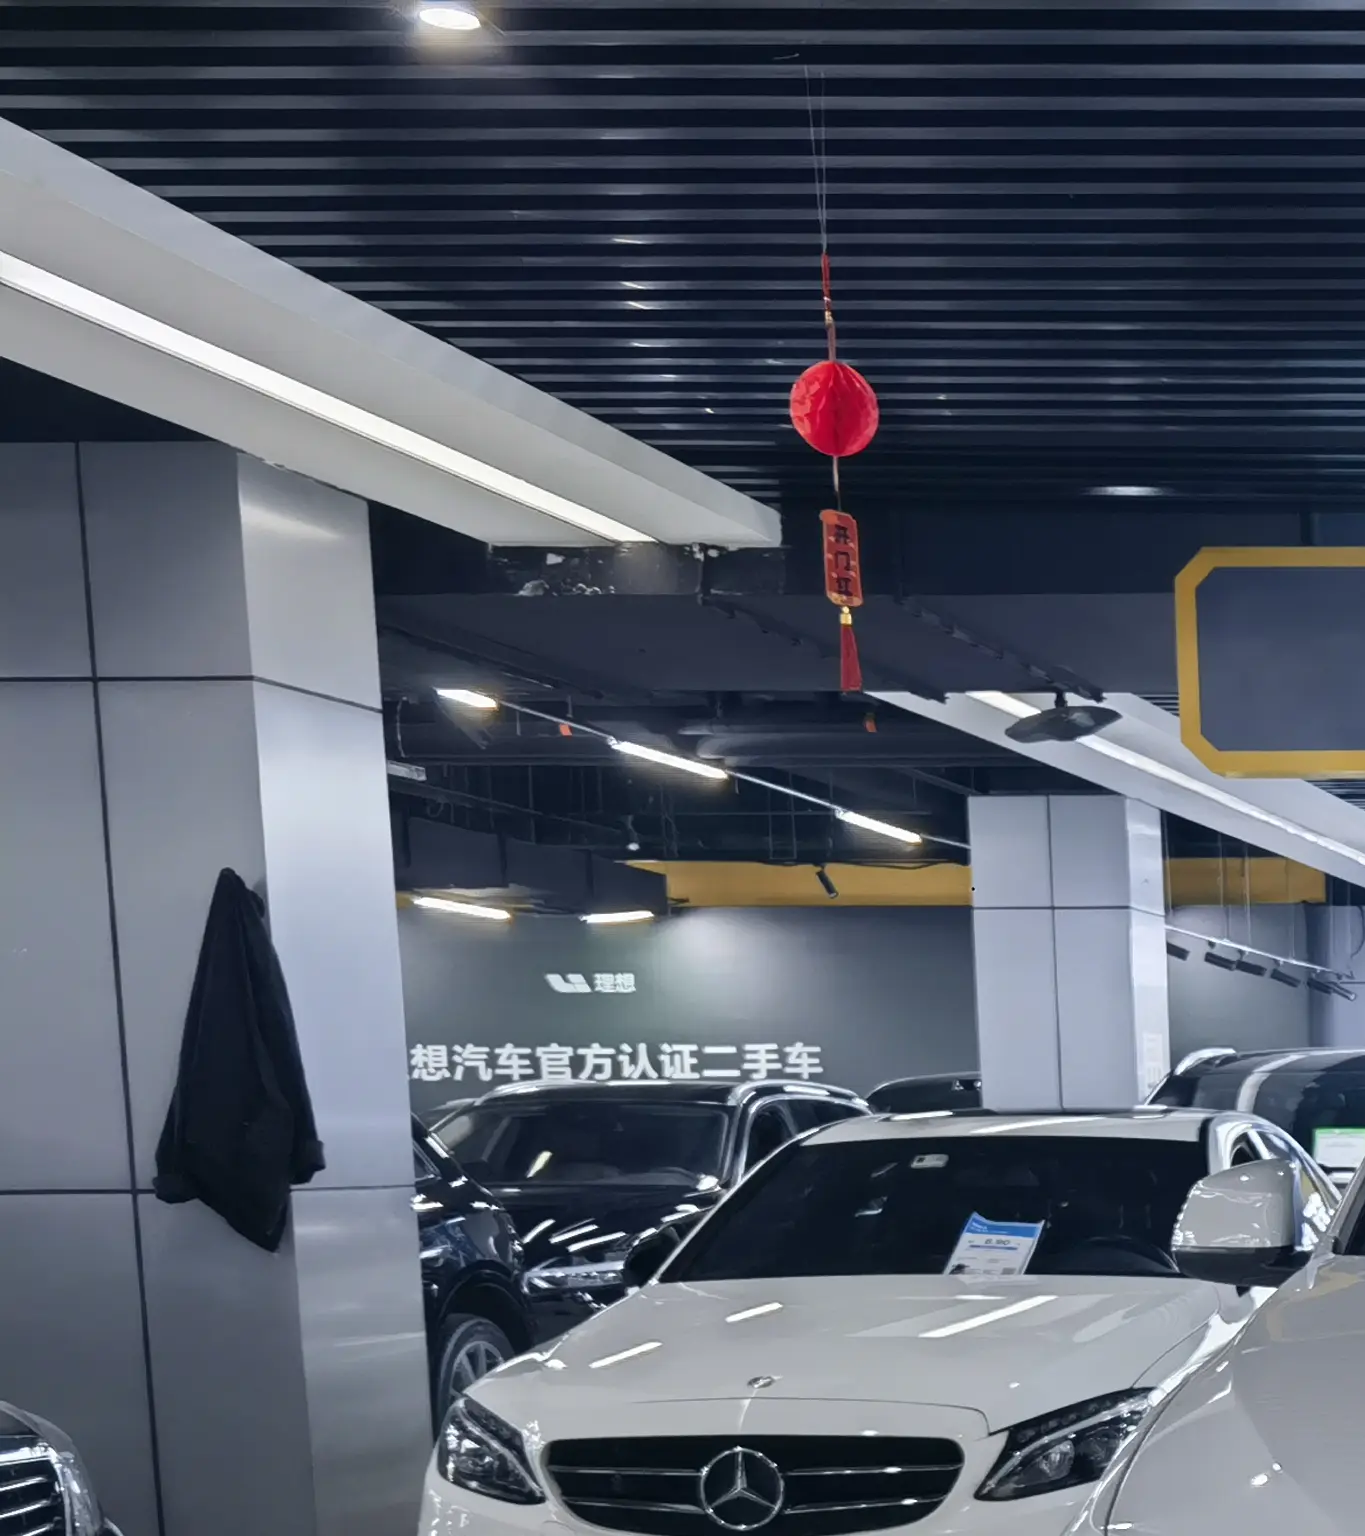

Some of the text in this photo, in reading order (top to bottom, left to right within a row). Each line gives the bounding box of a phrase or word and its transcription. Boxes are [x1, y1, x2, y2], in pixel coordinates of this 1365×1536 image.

[593, 972, 636, 993] 理想
[405, 1042, 824, 1082] 想汽车官方认证二手车
